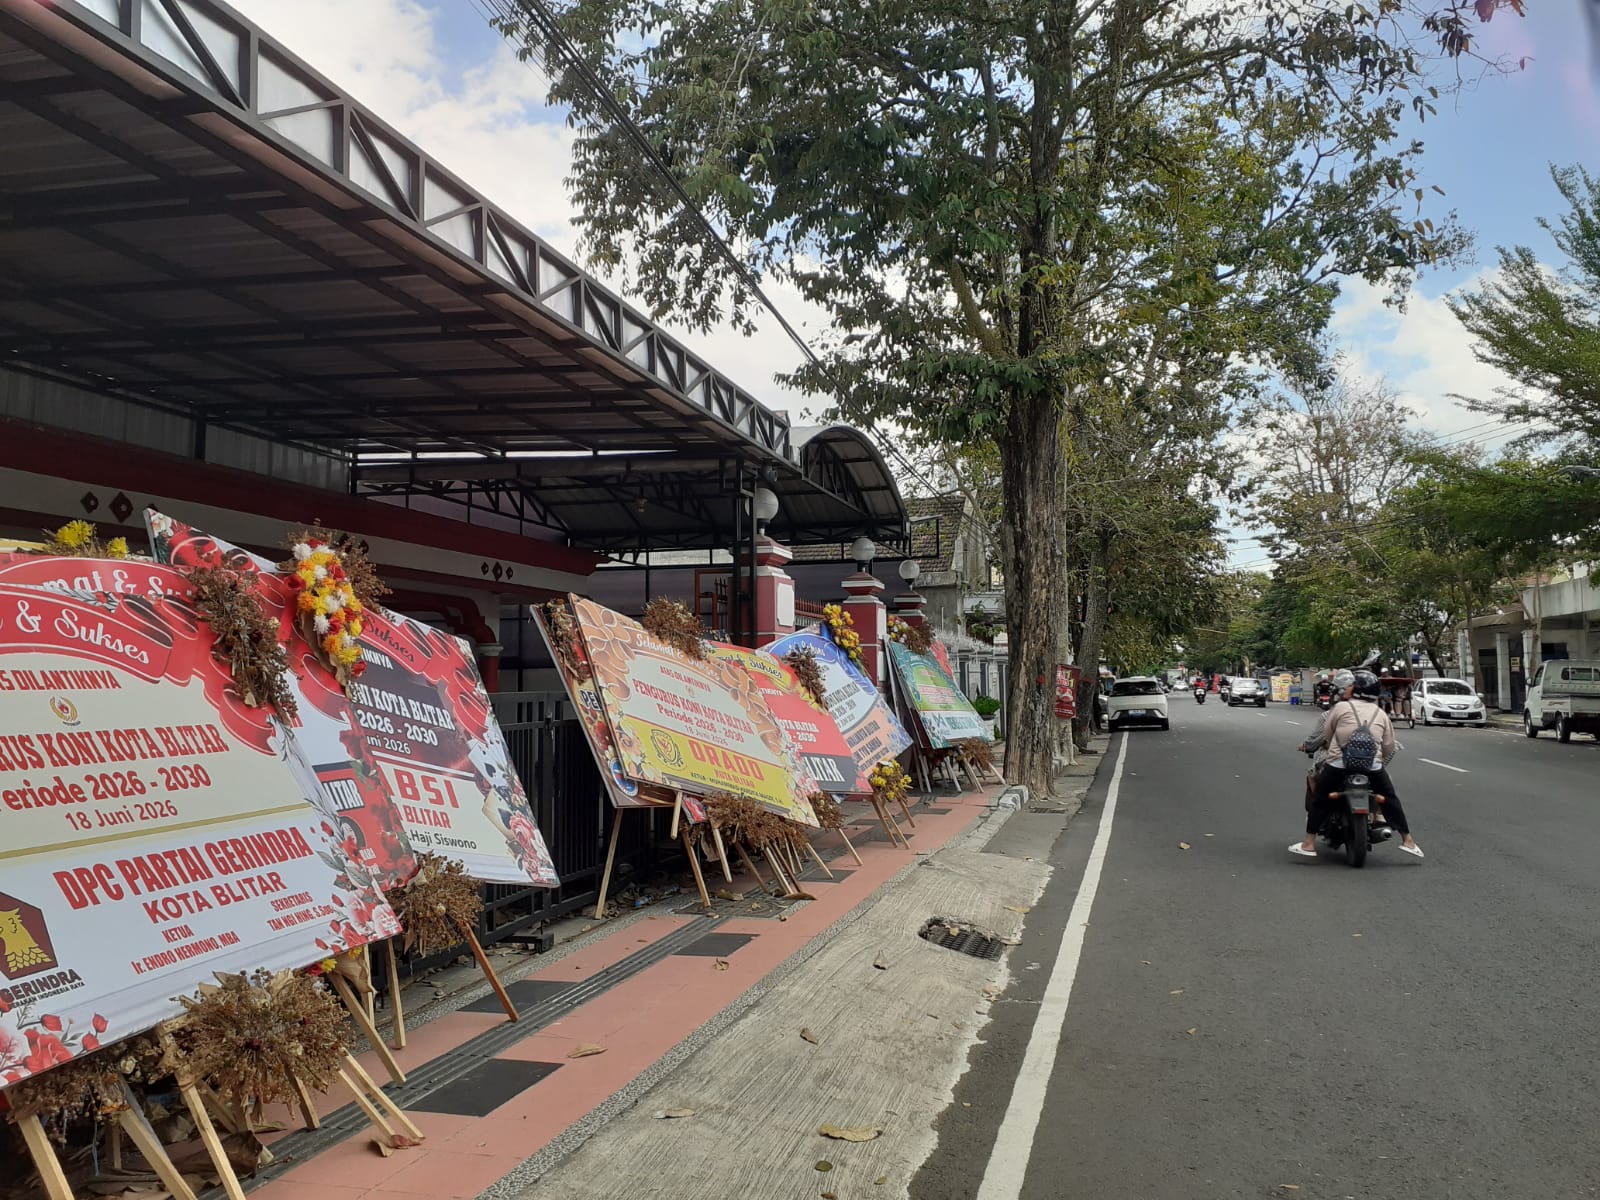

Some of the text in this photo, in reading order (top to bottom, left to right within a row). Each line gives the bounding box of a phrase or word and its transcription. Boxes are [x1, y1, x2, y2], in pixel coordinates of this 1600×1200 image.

[16, 600, 149, 664] & Sukses
[365, 613, 414, 663] Sukses
[11, 670, 122, 690] DILANTIKNYA
[632, 678, 682, 708] PENGURUS
[356, 709, 394, 735] 2026
[403, 722, 439, 747] 2030
[371, 687, 412, 718] KOTA
[411, 702, 456, 731] BLITAR
[36, 731, 107, 767] KONI
[96, 728, 165, 761] KOTA
[154, 724, 230, 757] BLITAR
[383, 737, 411, 754] 2026
[0, 776, 88, 811] eriode
[84, 770, 146, 800] 2026
[157, 763, 212, 791] 2030
[65, 799, 178, 831] 18 Juni 2026
[402, 804, 452, 829] BLITAR
[434, 833, 477, 850] Siswono
[53, 826, 315, 910] DPC PARTAI GERINDRA
[143, 871, 288, 924] KOTA BLITAR
[271, 891, 313, 912] SEKRETARIS
[131, 960, 147, 976] Ir.
[143, 951, 178, 973] ENDRO
[218, 930, 241, 949] MBA
[162, 924, 195, 944] KETUA
